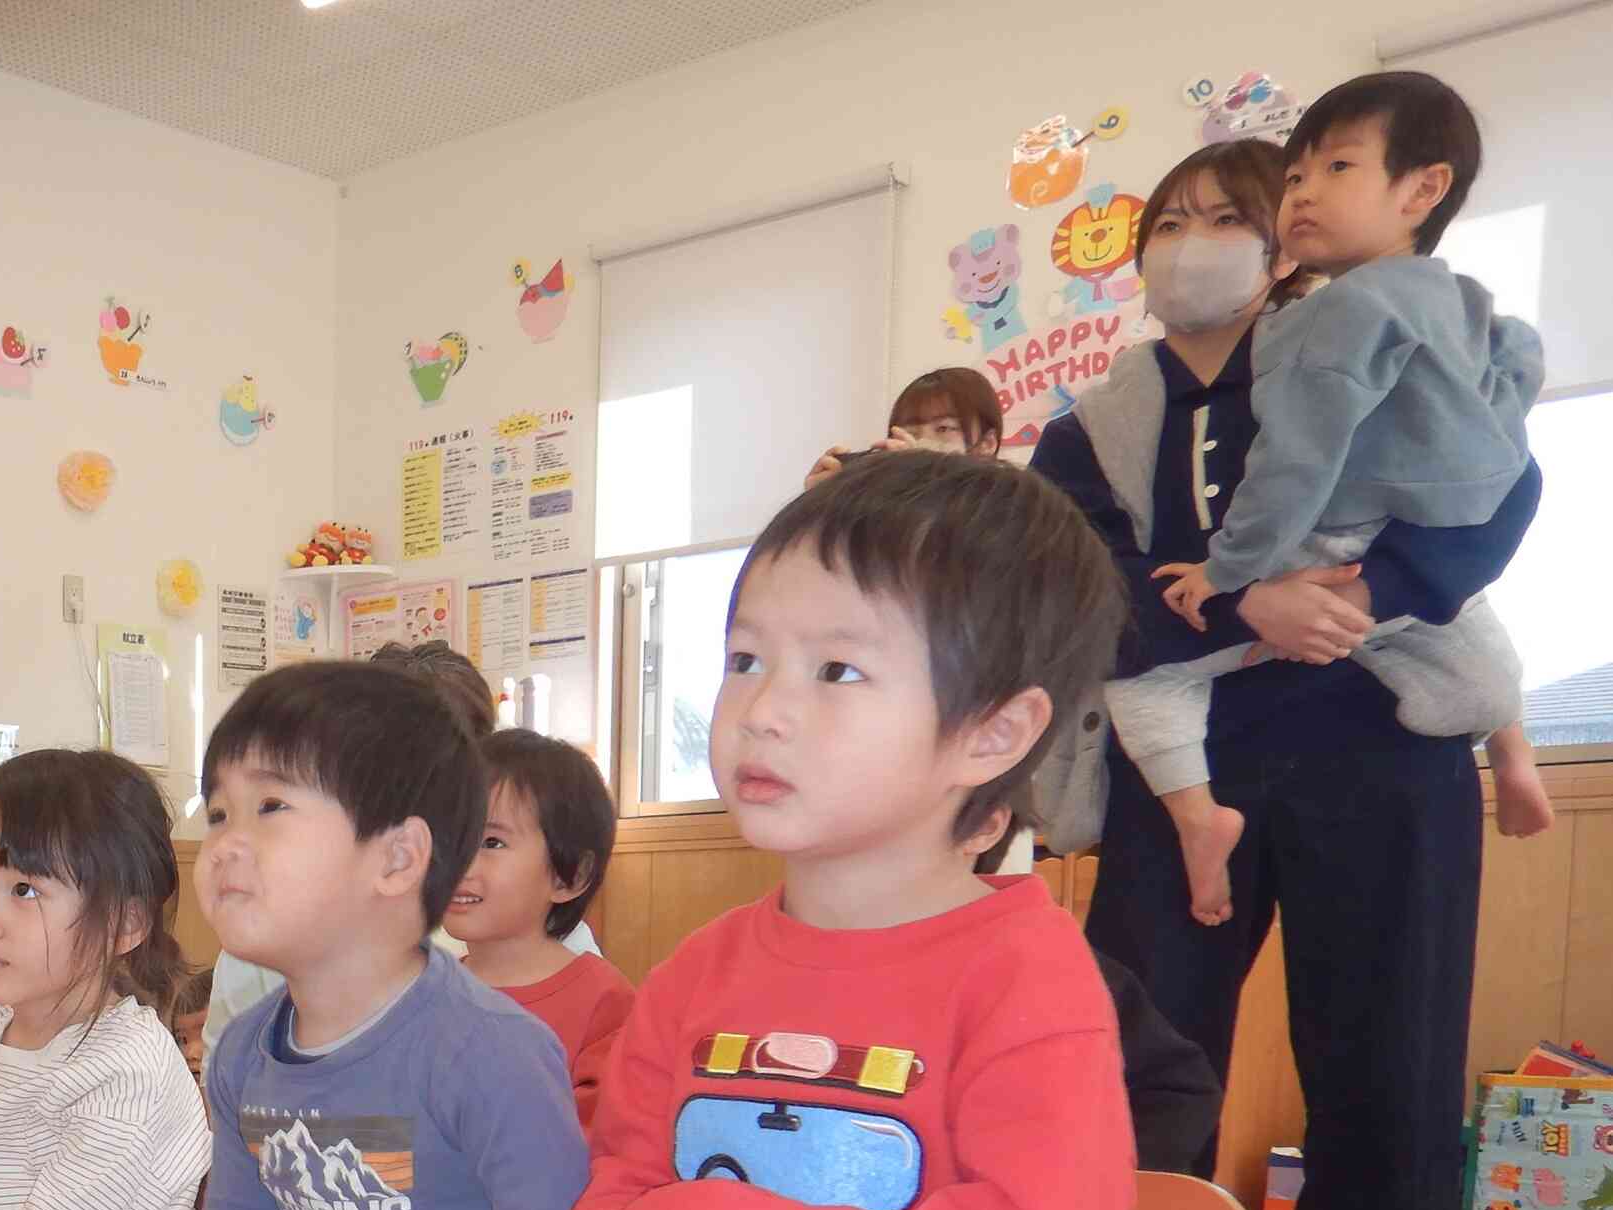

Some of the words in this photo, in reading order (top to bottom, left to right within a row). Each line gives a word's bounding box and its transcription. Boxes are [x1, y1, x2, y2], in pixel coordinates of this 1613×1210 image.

[1188, 79, 1213, 102] 10
[987, 315, 1120, 383] HAPPY
[996, 345, 1126, 415] BIRTHD
